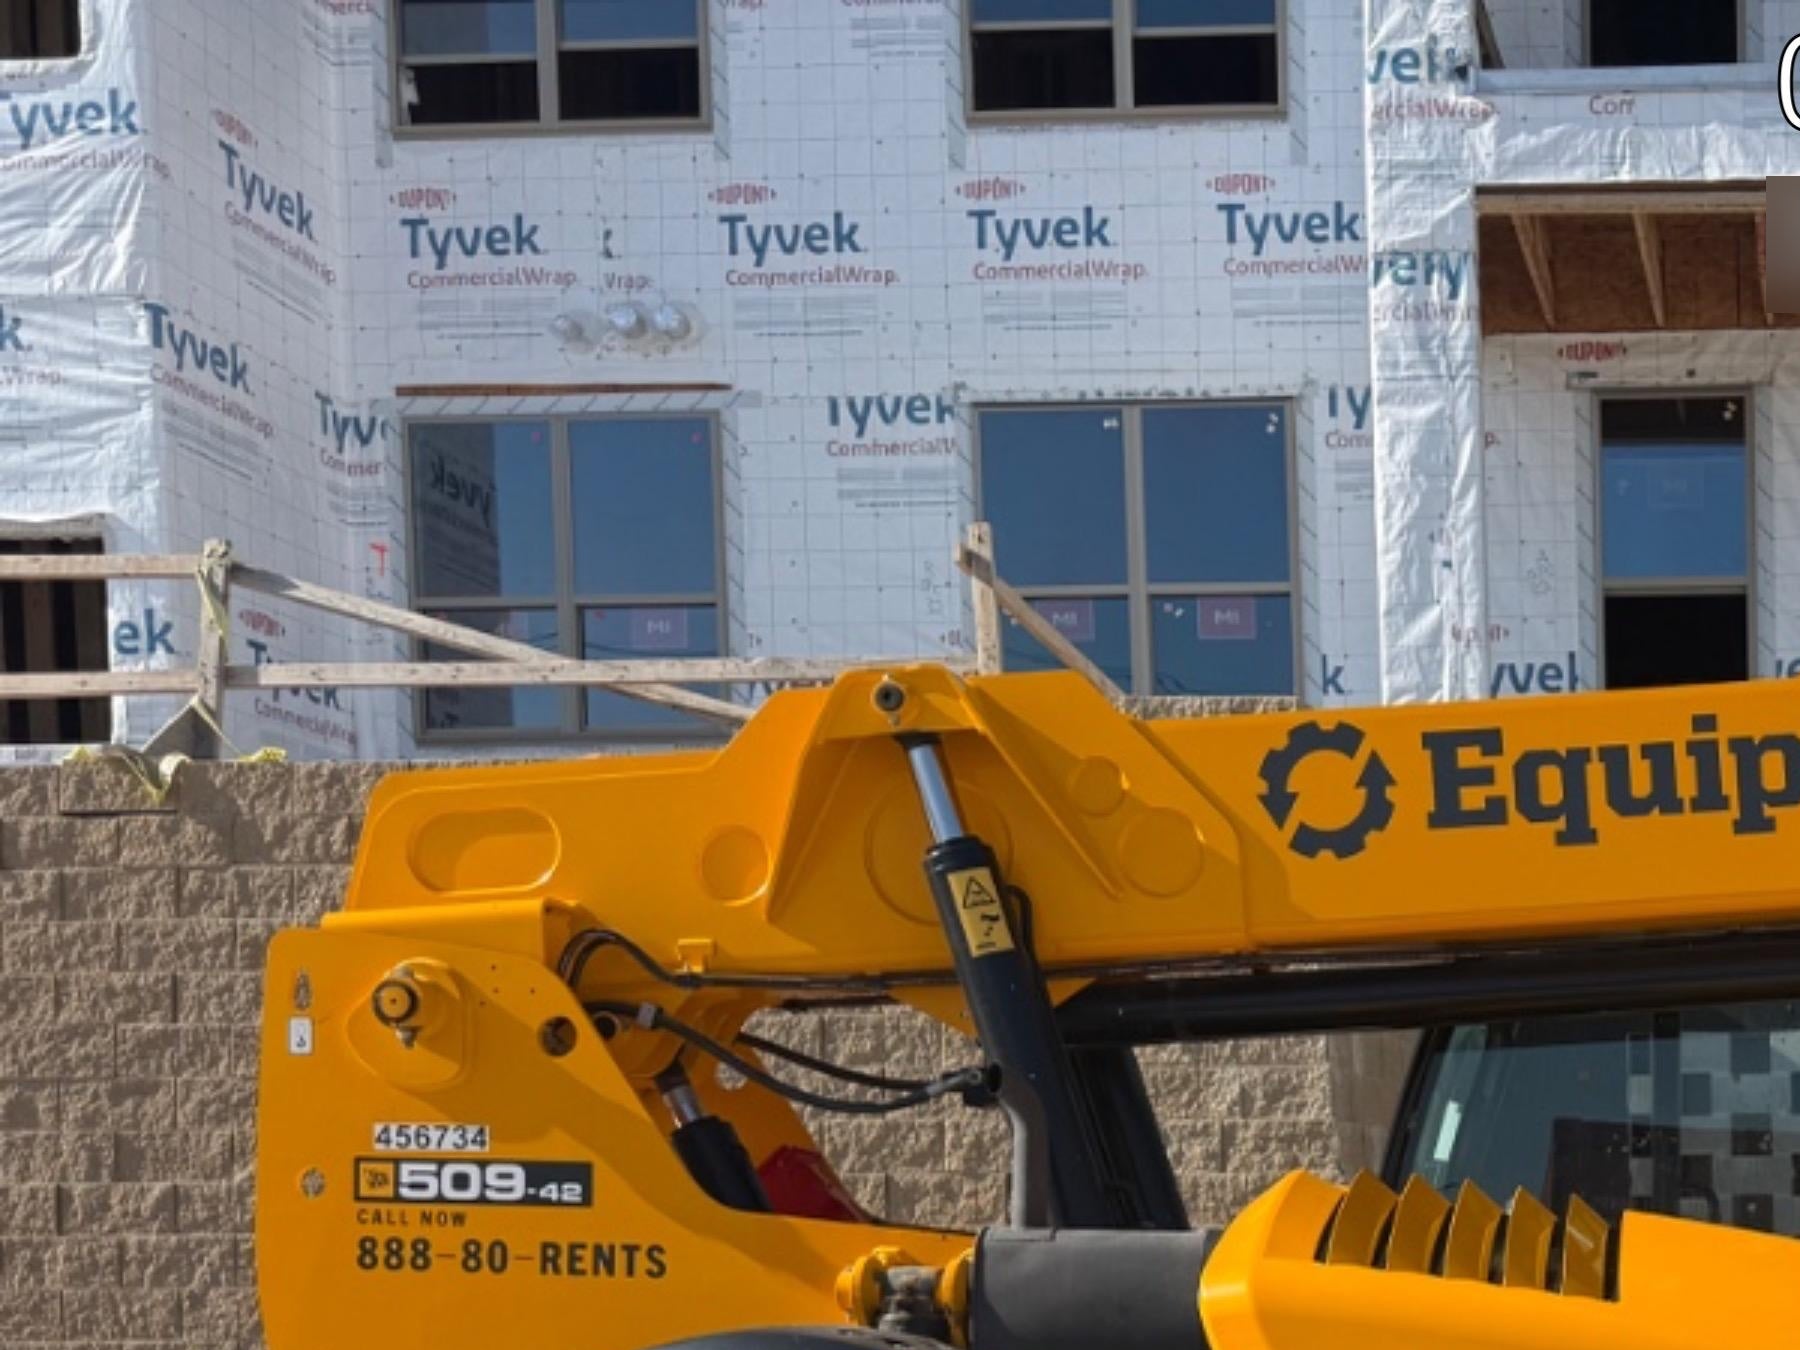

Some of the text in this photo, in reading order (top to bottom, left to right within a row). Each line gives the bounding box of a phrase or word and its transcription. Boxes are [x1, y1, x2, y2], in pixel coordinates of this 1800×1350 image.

[218, 137, 314, 243] Tyvek
[400, 213, 541, 271] Tyvek
[719, 211, 862, 268] Tyvek
[966, 205, 1111, 261] Tyvek
[1217, 201, 1361, 256] Tyvek
[407, 265, 577, 291] CommercialWrap
[725, 264, 897, 287] CommercialWrap
[973, 257, 1146, 281] CommercialWrap
[144, 302, 250, 392] Tyvek
[374, 1125, 487, 1150] 456734
[356, 1208, 467, 1227] CALL NOW
